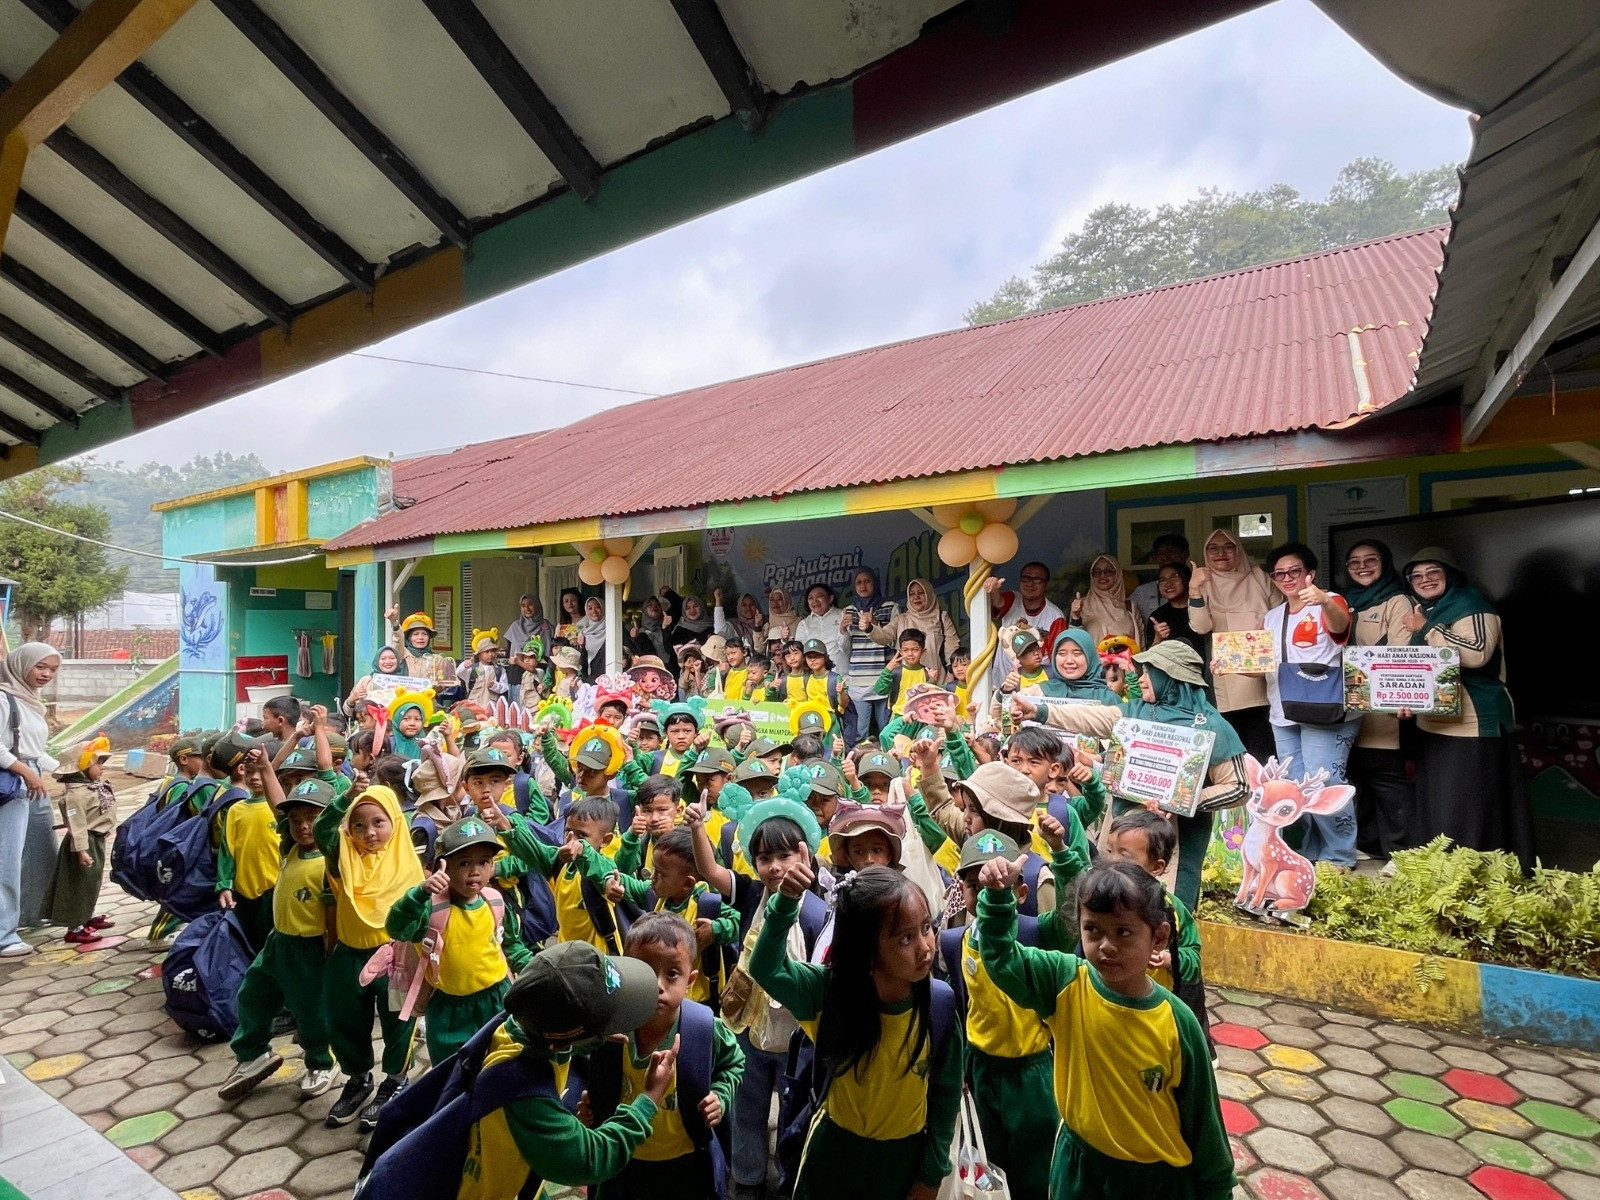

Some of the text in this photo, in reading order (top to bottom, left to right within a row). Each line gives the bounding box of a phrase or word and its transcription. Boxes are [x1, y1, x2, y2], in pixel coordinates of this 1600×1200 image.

[764, 546, 863, 582] Perhutani
[1377, 692, 1386, 700] Rp
[1154, 731, 1167, 739] ANAK
[1168, 733, 1191, 744] NASIONAL
[1128, 770, 1136, 781] Rp
[1137, 772, 1172, 788] 2.500.000
